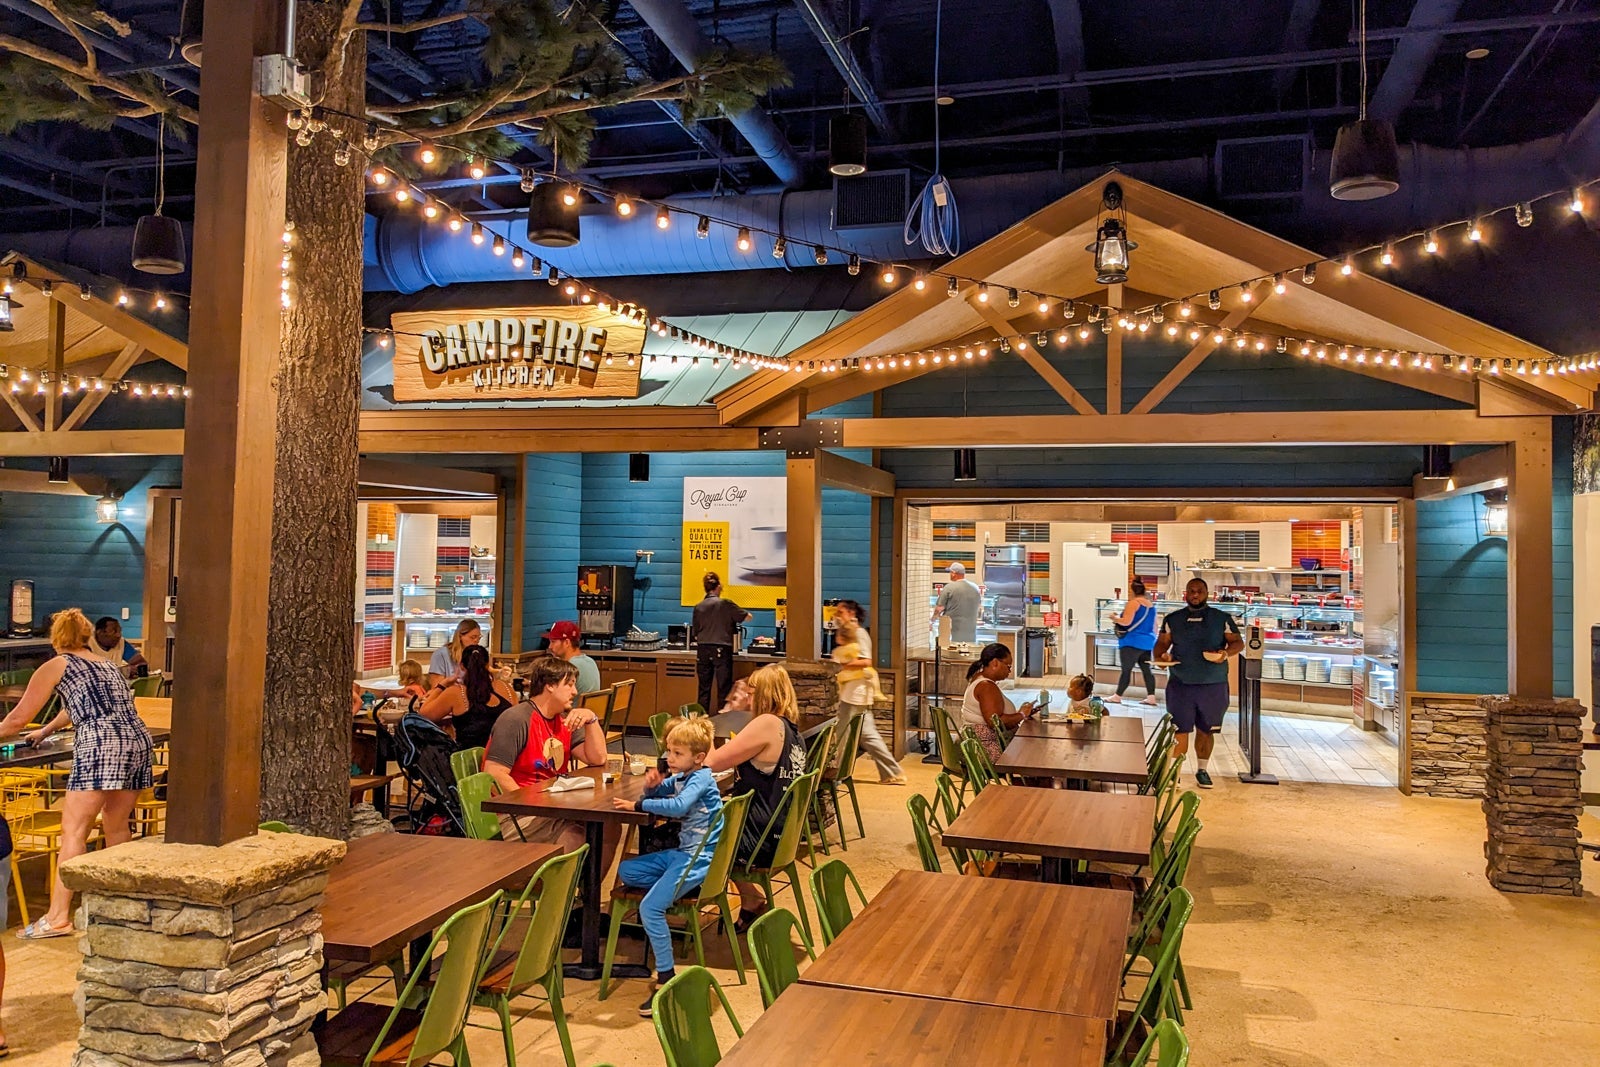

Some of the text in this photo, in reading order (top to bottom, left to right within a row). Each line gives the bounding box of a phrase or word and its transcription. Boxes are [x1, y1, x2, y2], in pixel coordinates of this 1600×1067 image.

[421, 318, 607, 373] CAMPFIRE
[472, 366, 555, 387] KITCHEN
[690, 485, 748, 510] Royal Cup
[689, 549, 722, 560] TASTE
